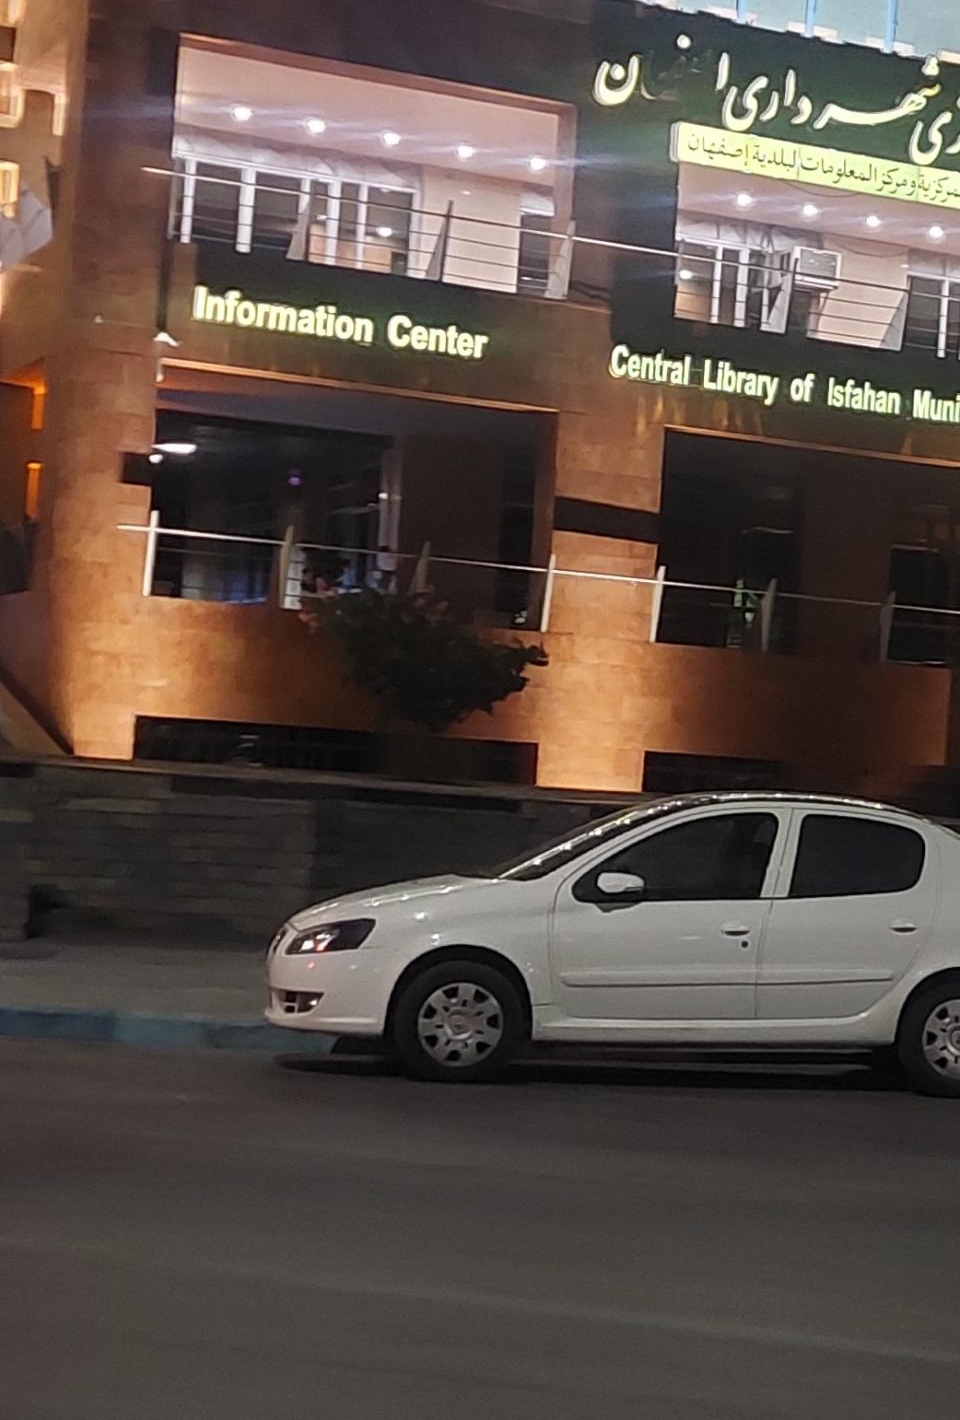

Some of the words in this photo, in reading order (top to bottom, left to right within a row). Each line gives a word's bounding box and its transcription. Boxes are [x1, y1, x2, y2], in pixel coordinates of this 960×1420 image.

[193, 285, 375, 345] Information
[387, 313, 490, 359] Center
[609, 344, 692, 386] Central
[703, 358, 780, 406] Library
[789, 373, 816, 403] of
[827, 376, 901, 415] Isfahan
